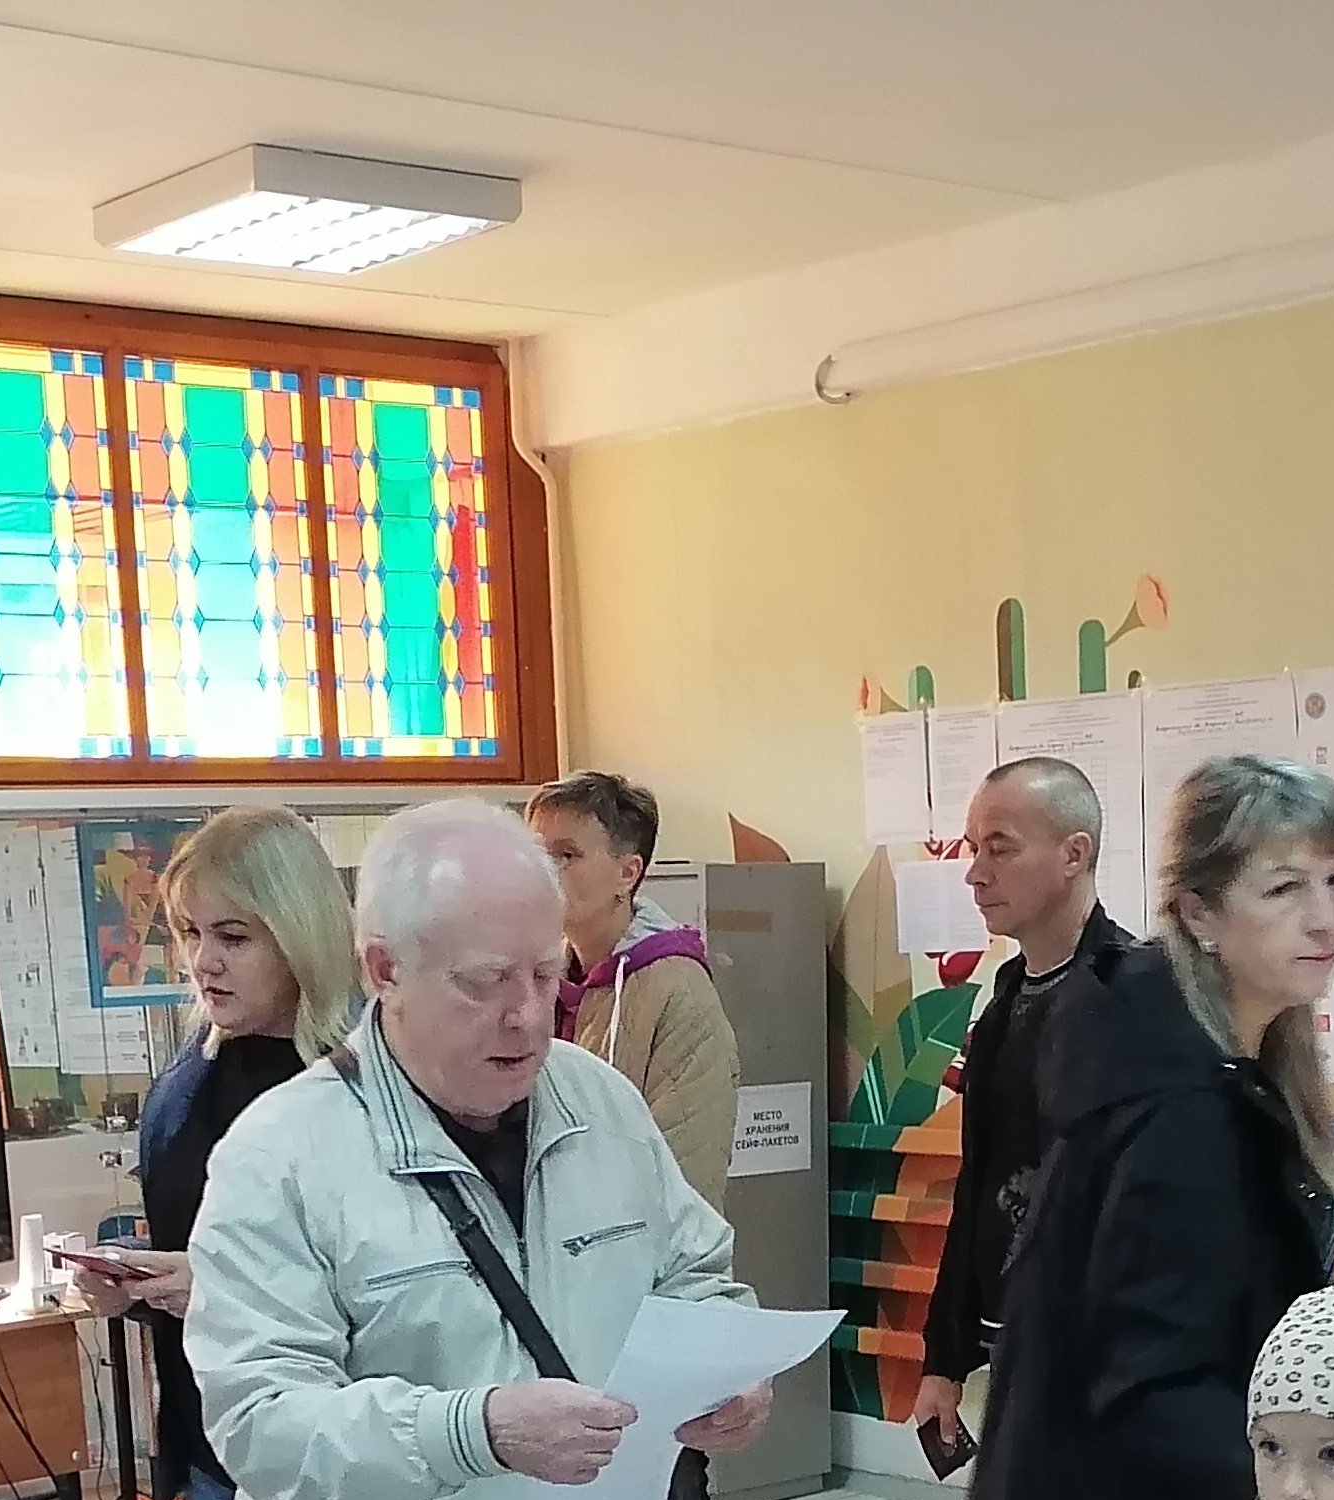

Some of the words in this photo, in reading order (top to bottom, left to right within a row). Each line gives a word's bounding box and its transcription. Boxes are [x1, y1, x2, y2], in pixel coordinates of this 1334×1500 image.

[753, 1110, 783, 1121] МЕСТО
[745, 1122, 790, 1136] ХРАНЕНИЯ
[735, 1135, 799, 1150] СЕЙФ-ПАКЕТОВ
